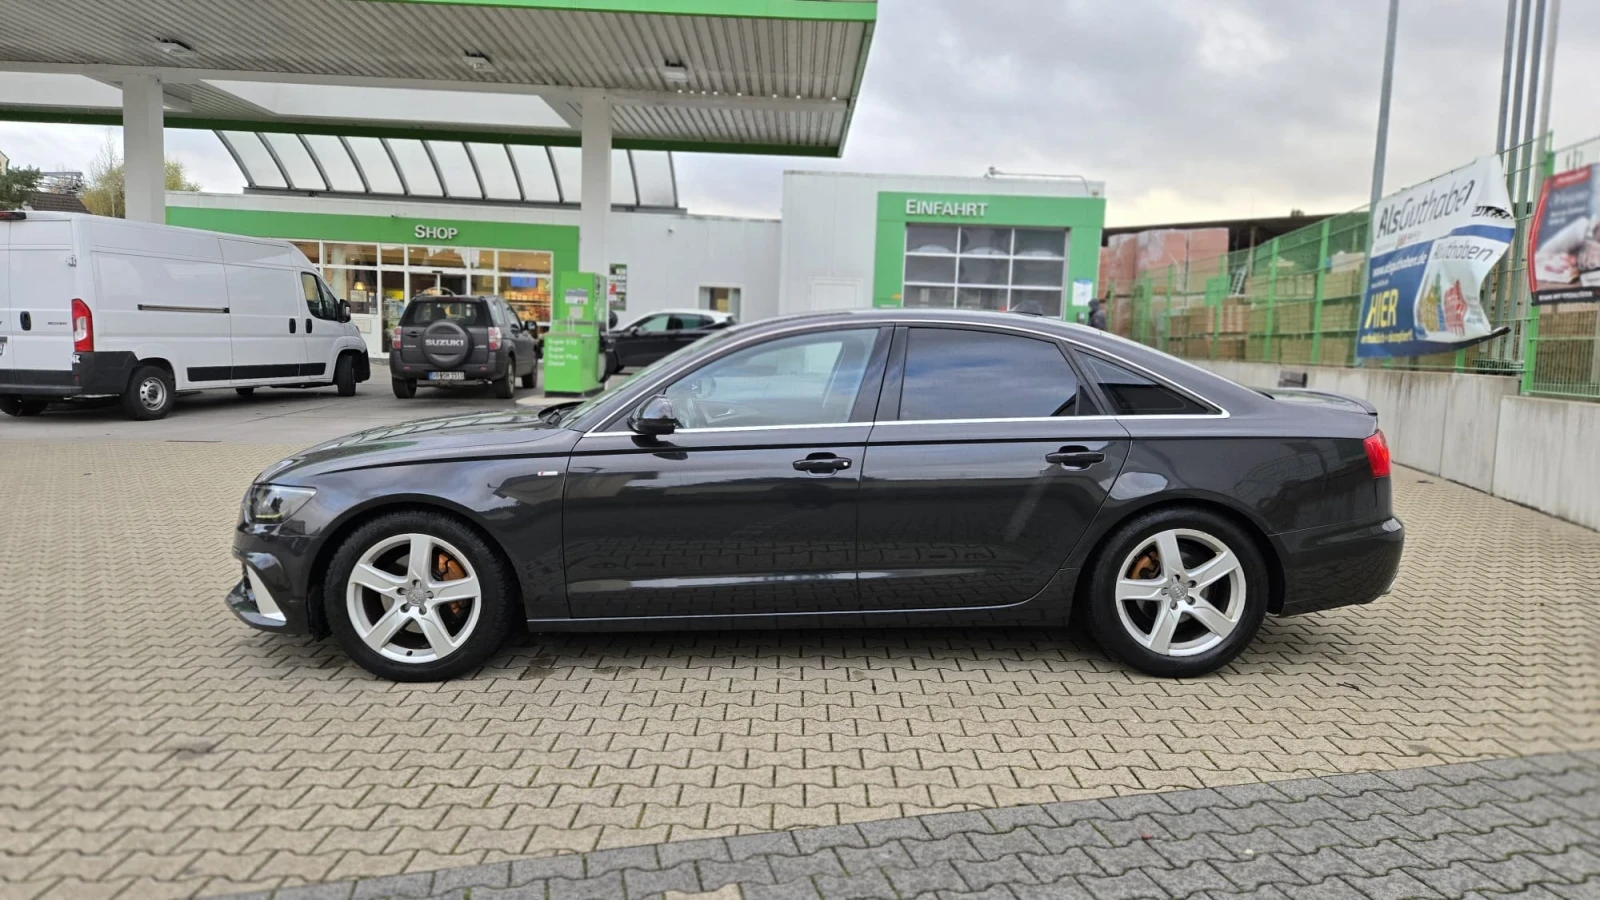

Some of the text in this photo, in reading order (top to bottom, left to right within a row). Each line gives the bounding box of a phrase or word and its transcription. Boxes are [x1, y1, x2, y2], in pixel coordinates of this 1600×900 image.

[905, 199, 988, 216] EINFAHRT
[414, 224, 458, 240] SHOP
[1364, 288, 1398, 329] HIER
[425, 338, 465, 347] SUZUKI
